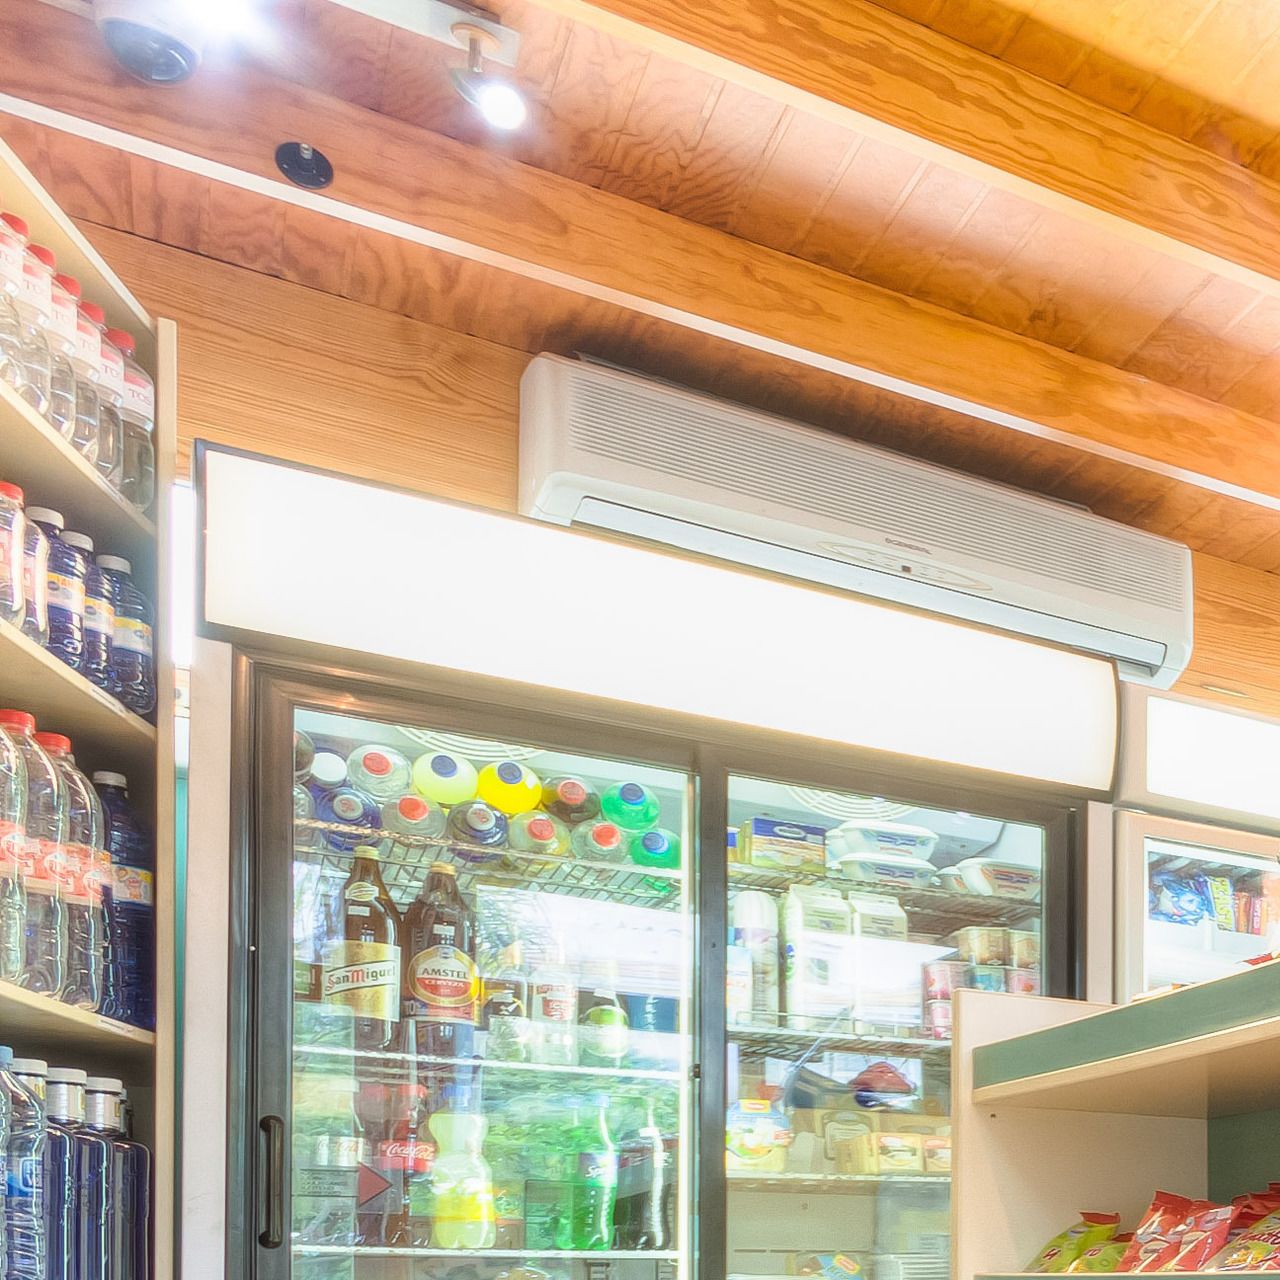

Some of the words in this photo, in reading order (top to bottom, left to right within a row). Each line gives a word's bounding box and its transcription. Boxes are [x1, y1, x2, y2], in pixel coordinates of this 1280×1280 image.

[326, 973, 349, 992] San
[351, 965, 396, 983] Miguel
[421, 967, 468, 977] AMSTEL
